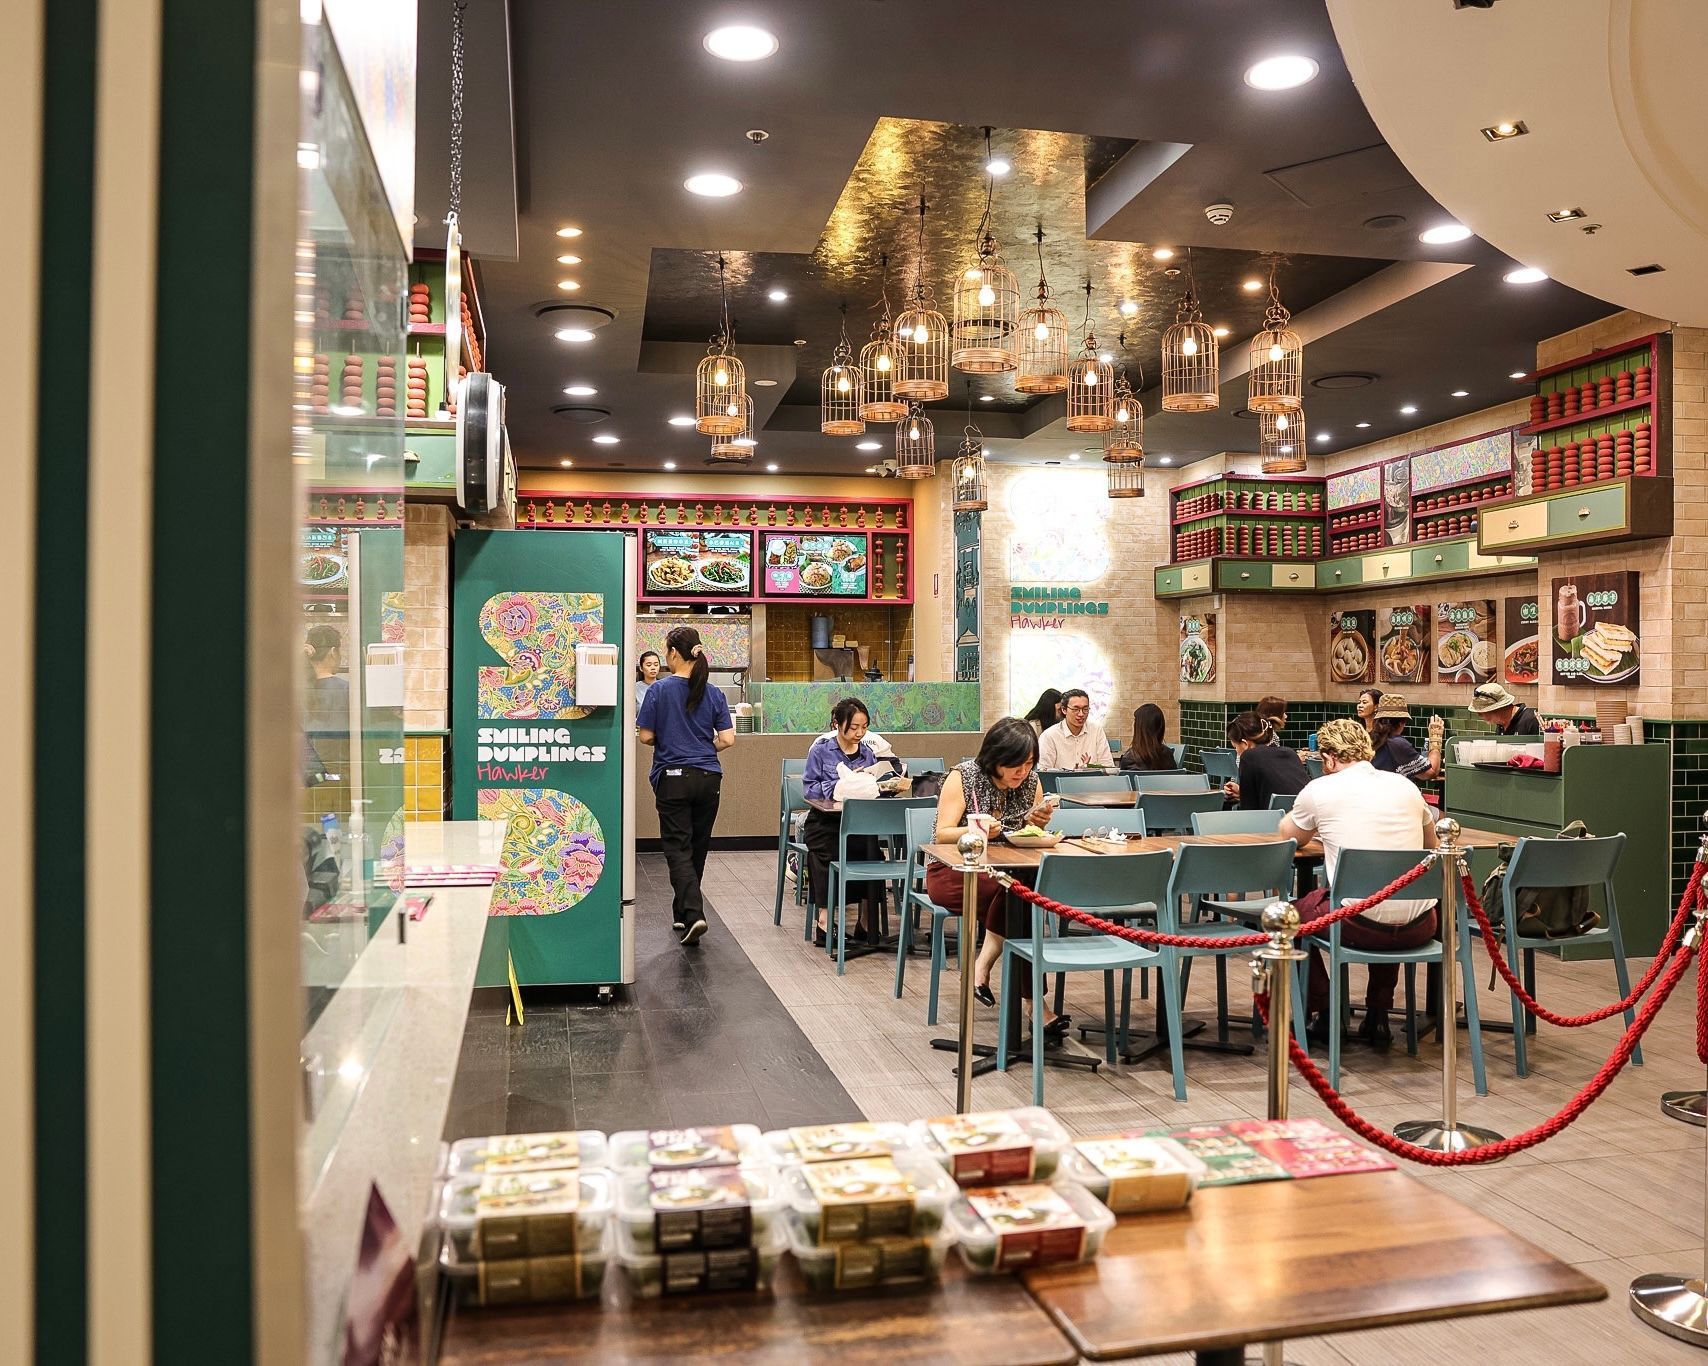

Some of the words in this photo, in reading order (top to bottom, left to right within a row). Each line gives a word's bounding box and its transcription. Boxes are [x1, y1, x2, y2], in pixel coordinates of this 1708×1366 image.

[1010, 587, 1081, 600] SMILING
[1010, 601, 1109, 615] DUMPLINGS
[1010, 615, 1065, 630] Hawker
[477, 727, 570, 744] SMILING
[477, 745, 607, 762] DUMPLINGS
[477, 762, 549, 782] Hawker
